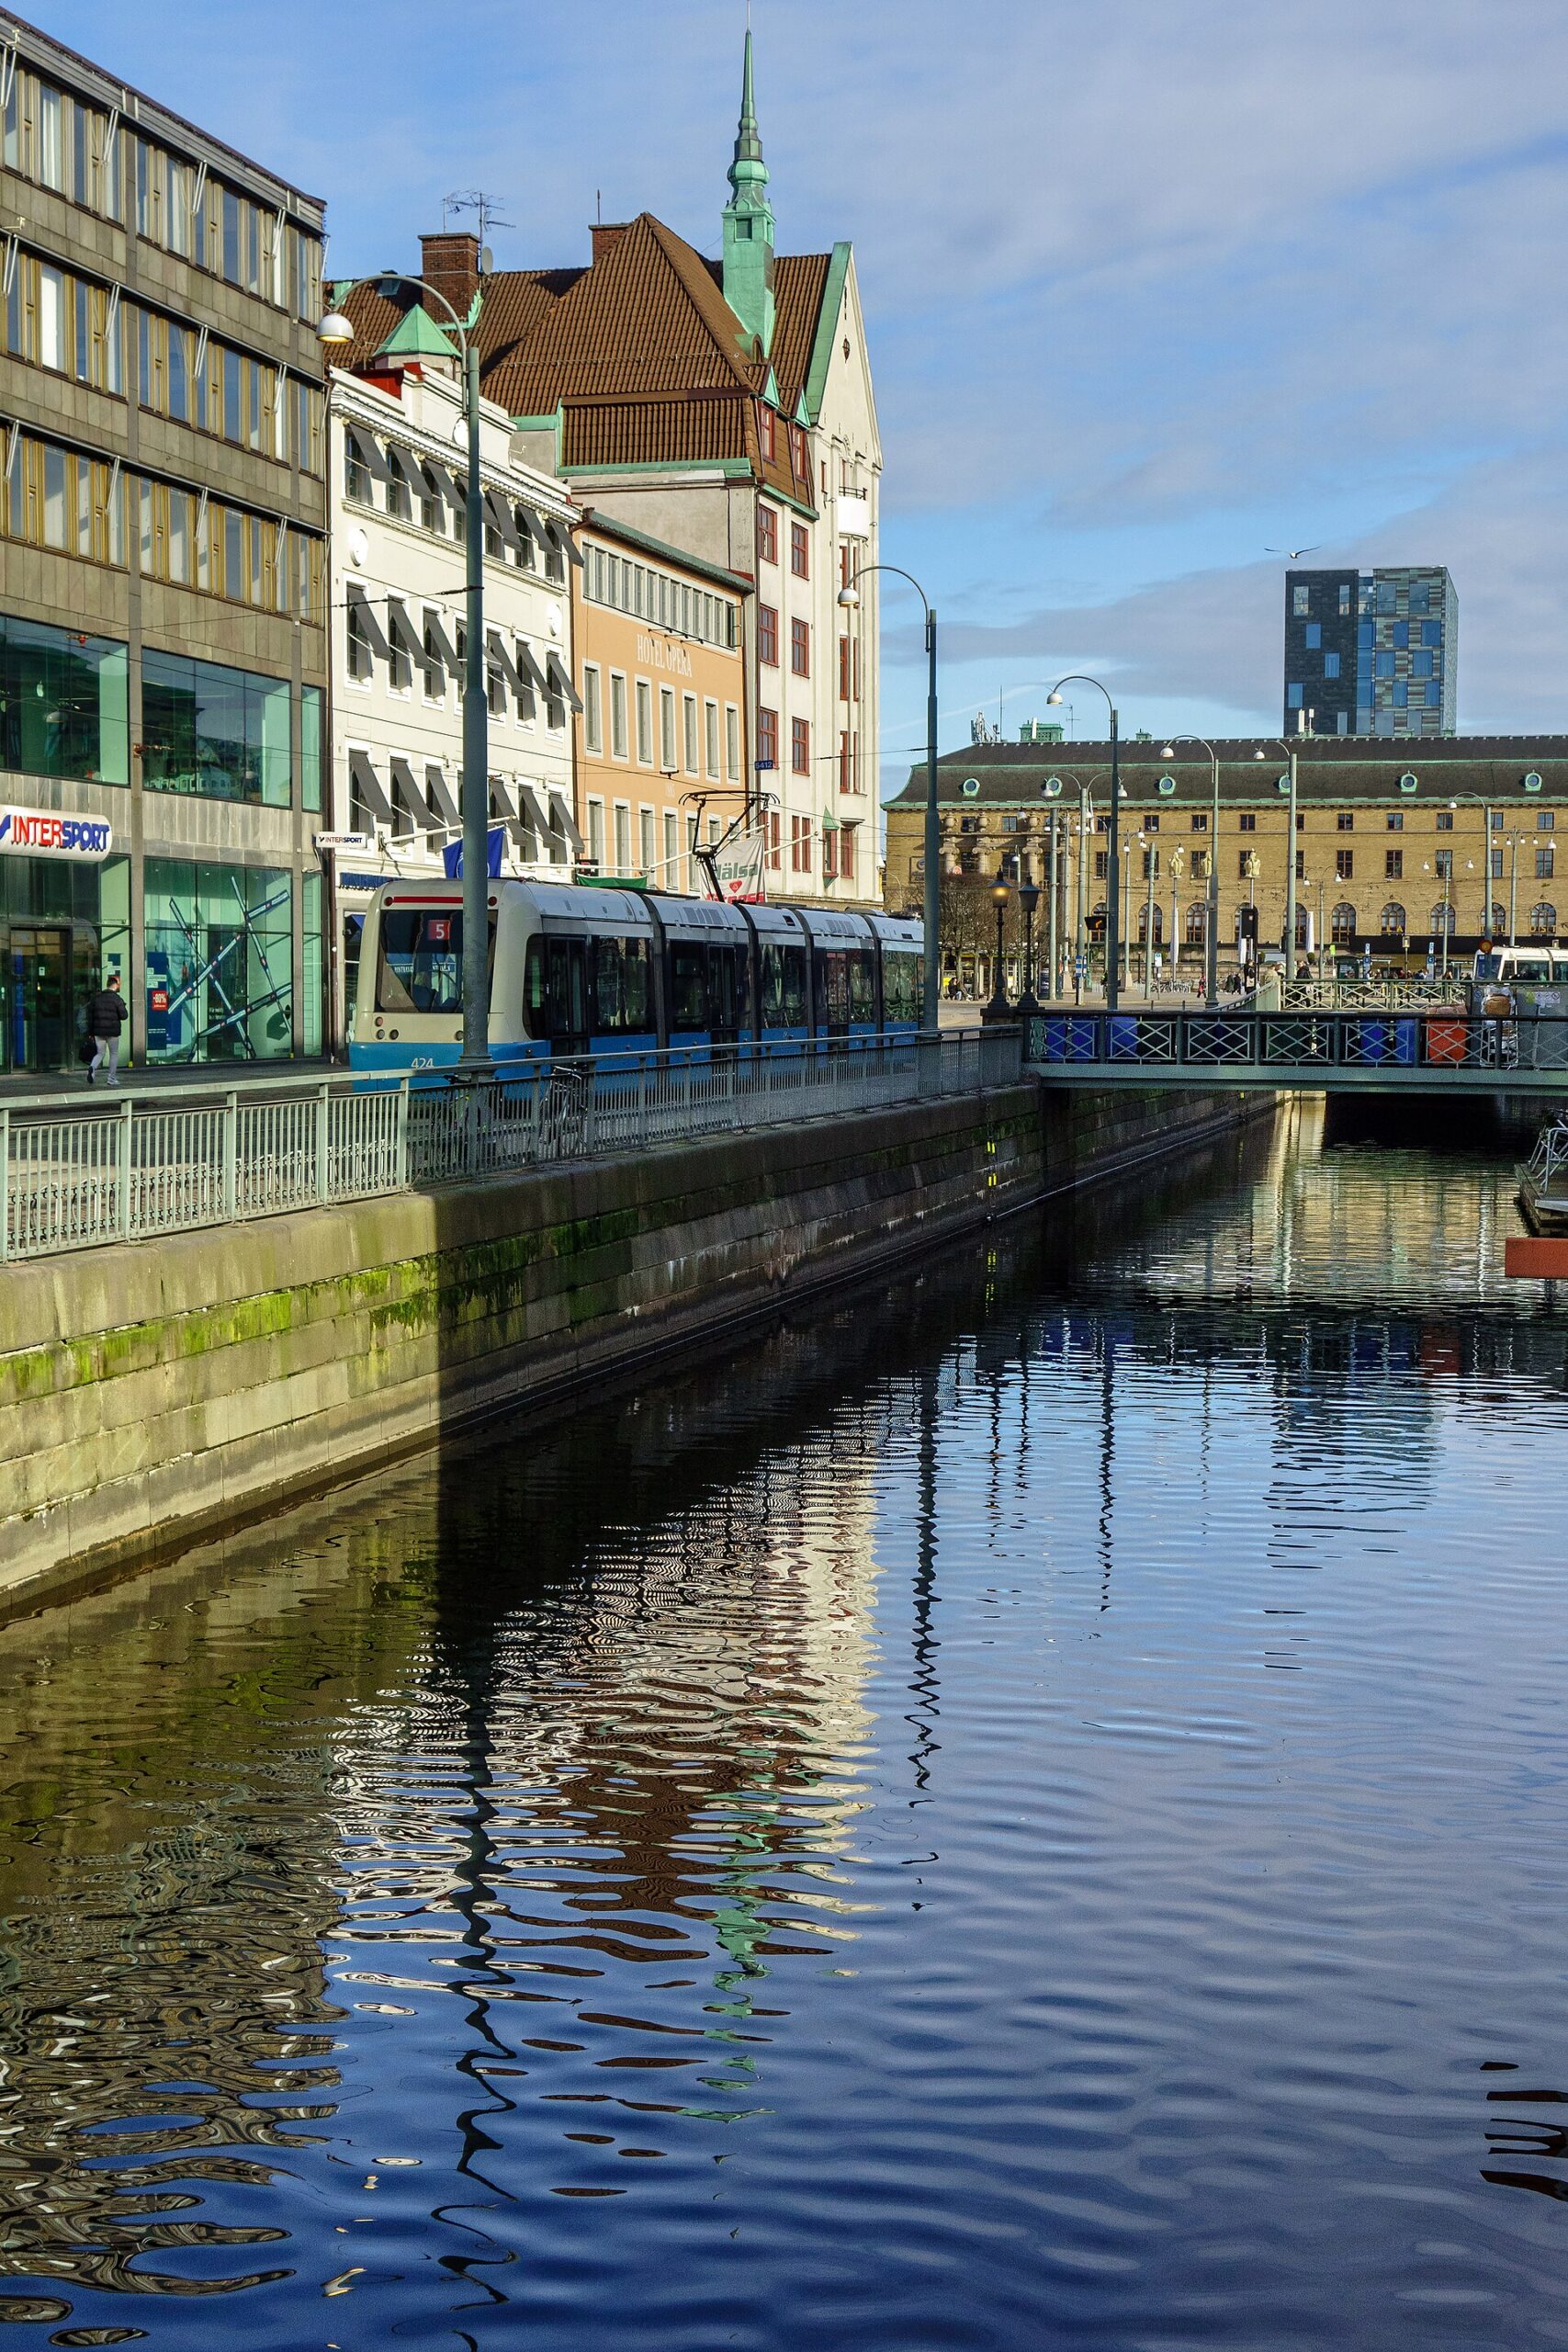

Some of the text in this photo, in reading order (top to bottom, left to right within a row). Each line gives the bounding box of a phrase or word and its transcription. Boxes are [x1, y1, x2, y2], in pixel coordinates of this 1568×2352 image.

[637, 633, 692, 677] HOTEL OPERA
[12, 815, 110, 851] INTERSPORT
[435, 923, 445, 939] 5
[411, 1057, 434, 1069] 424
